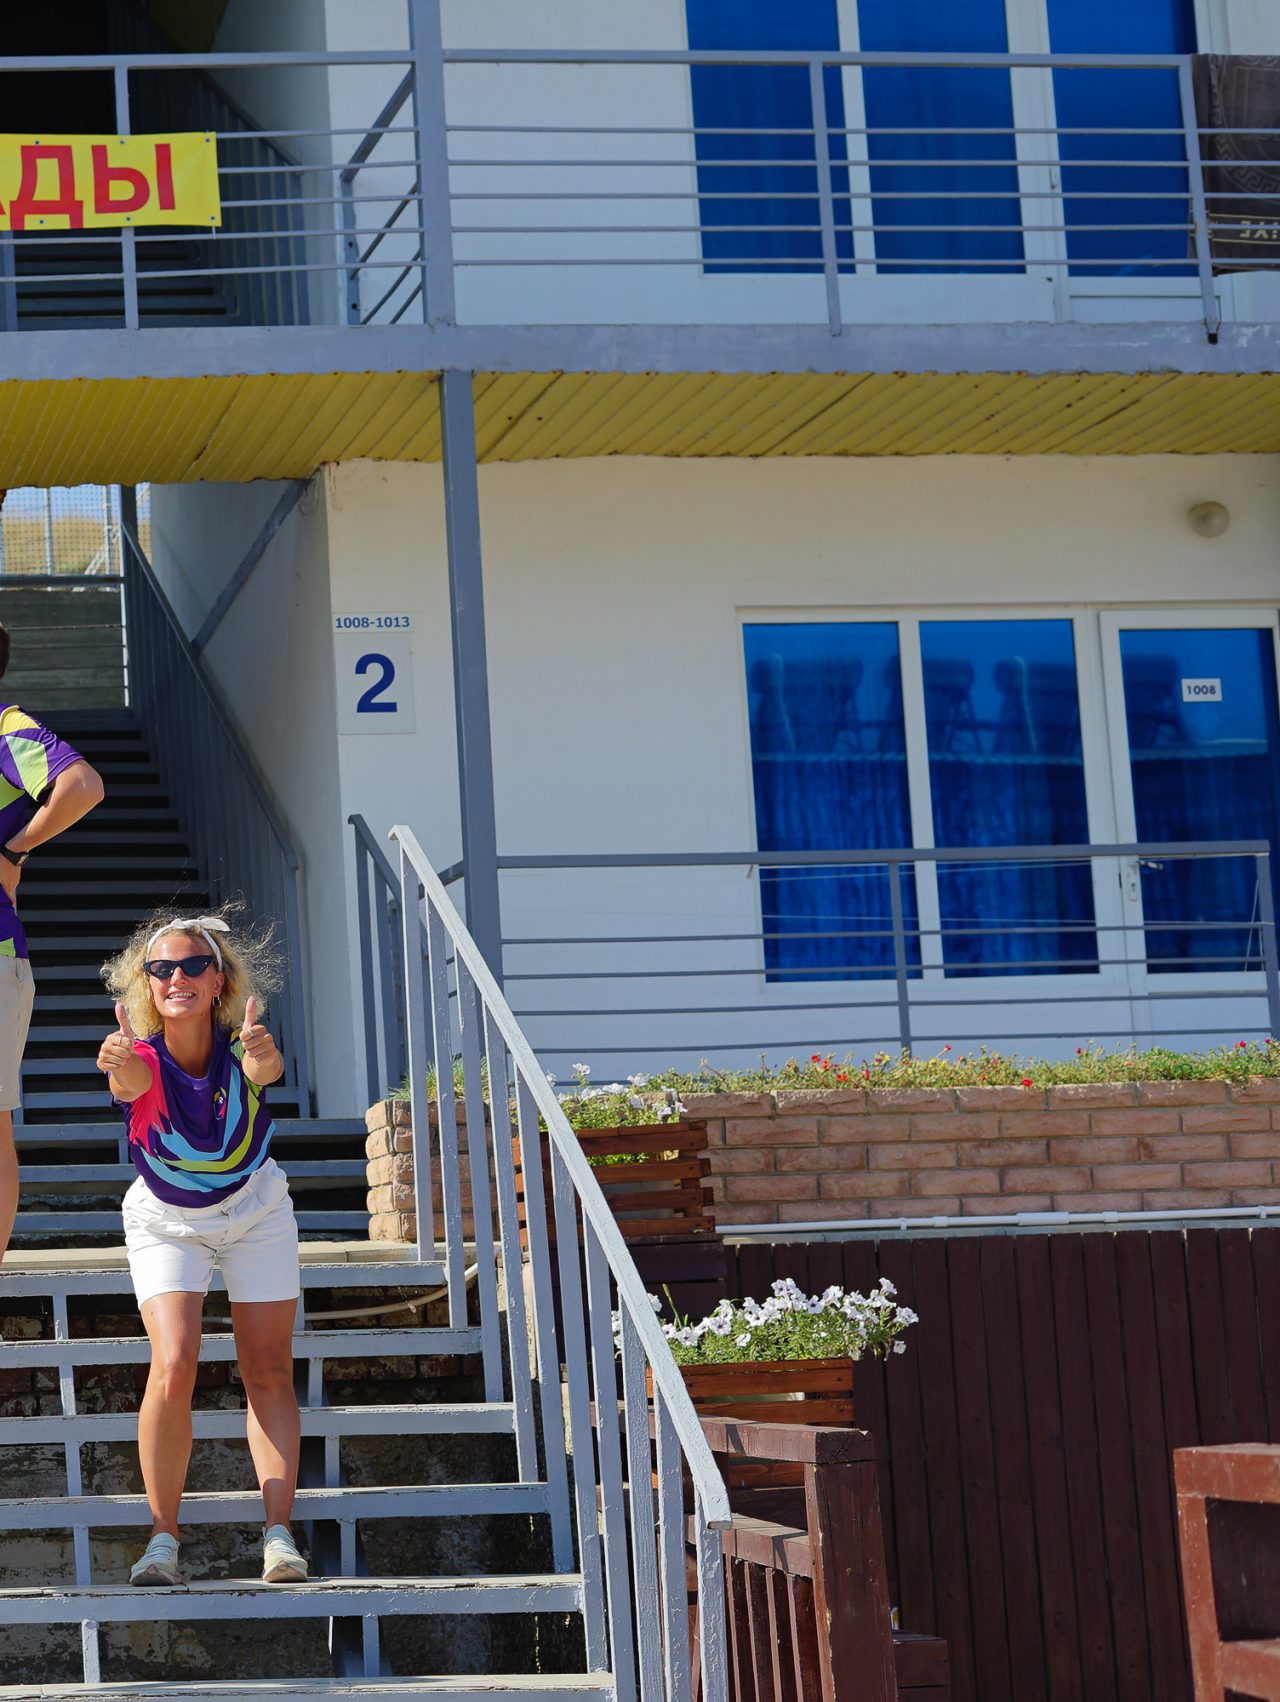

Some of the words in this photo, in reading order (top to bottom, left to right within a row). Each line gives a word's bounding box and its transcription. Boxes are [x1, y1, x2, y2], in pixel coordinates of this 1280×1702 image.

[335, 616, 410, 628] 1008-1013
[355, 653, 397, 713] 2
[1186, 685, 1216, 695] 1008
